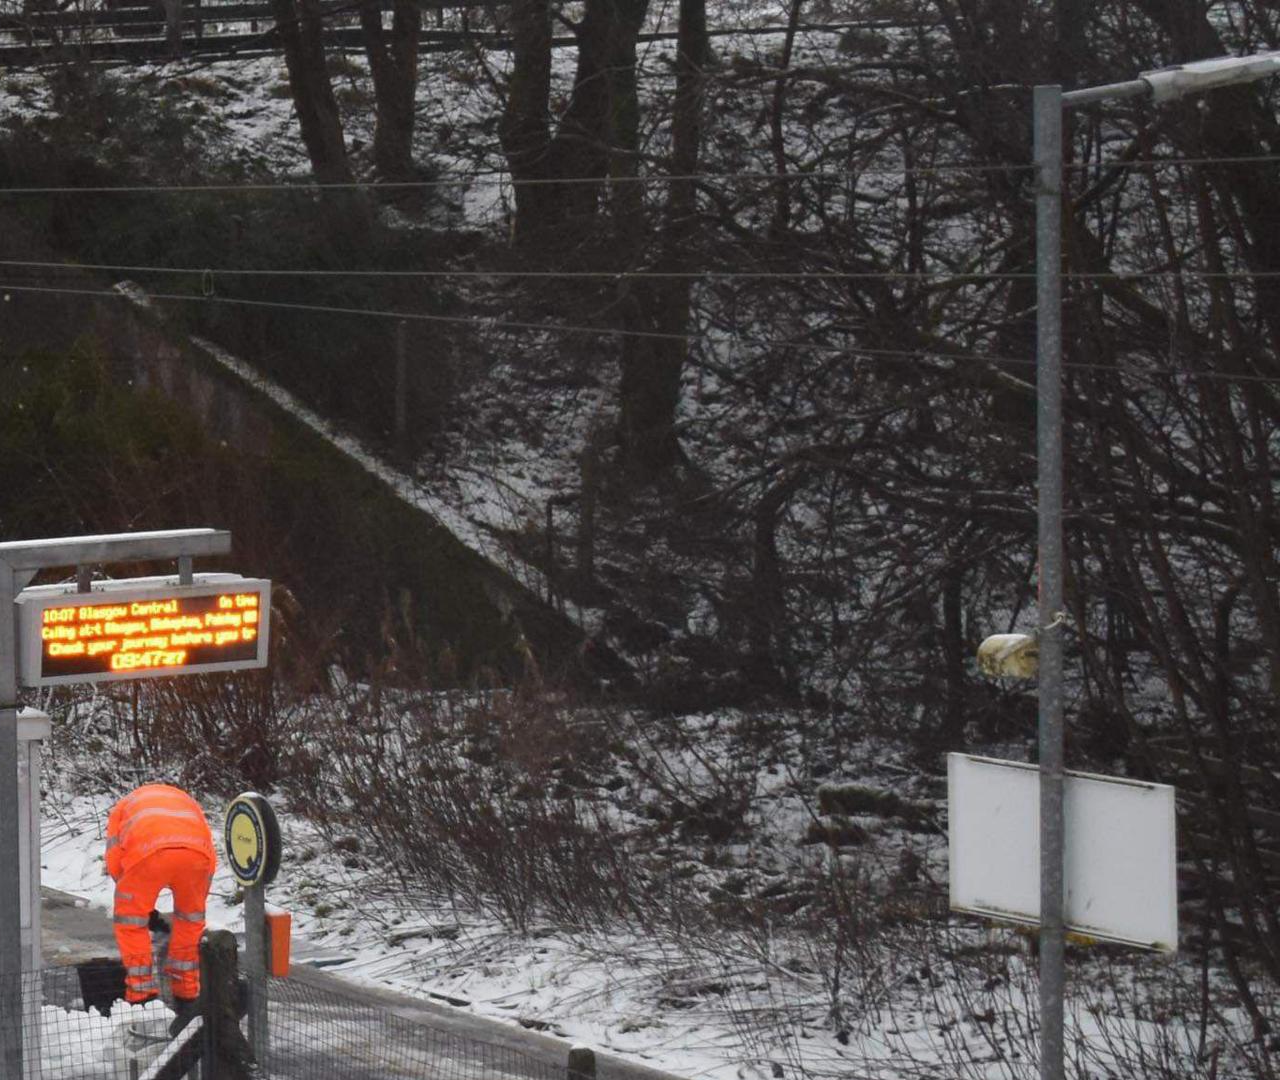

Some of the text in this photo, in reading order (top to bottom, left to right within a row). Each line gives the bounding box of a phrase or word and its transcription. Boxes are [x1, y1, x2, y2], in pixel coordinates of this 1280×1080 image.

[42, 608, 75, 624] 10:07
[78, 605, 127, 621] Glasgow
[130, 599, 178, 616] Central
[41, 624, 76, 640] Calling
[48, 640, 85, 656] Check
[86, 640, 117, 655] your
[120, 635, 168, 652] journey
[170, 631, 213, 646] before
[214, 630, 239, 645] you
